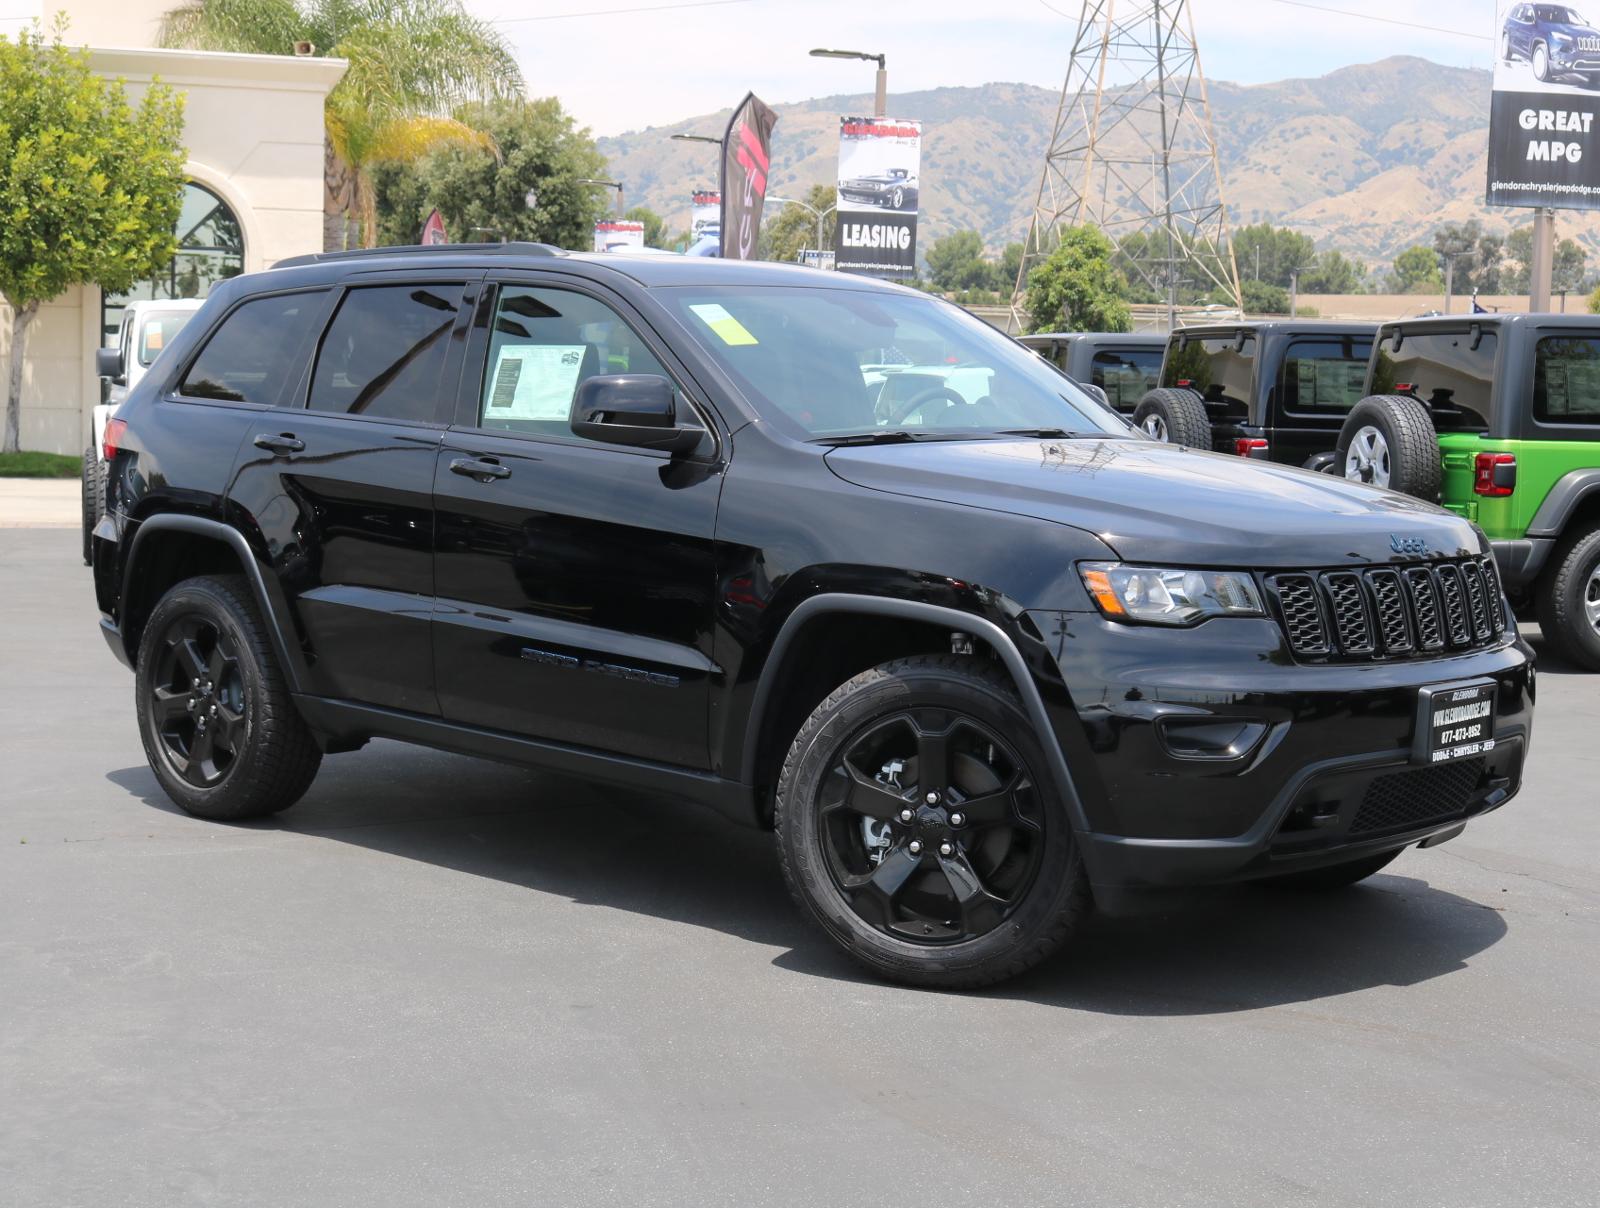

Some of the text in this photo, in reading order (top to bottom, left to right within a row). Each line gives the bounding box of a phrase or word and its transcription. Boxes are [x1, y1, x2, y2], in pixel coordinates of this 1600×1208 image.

[1518, 108, 1594, 133] GREAT
[1526, 140, 1582, 163] MPG
[842, 223, 911, 250] LEASING
[1390, 533, 1427, 557] Jeep
[1482, 740, 1495, 751] JEEP
